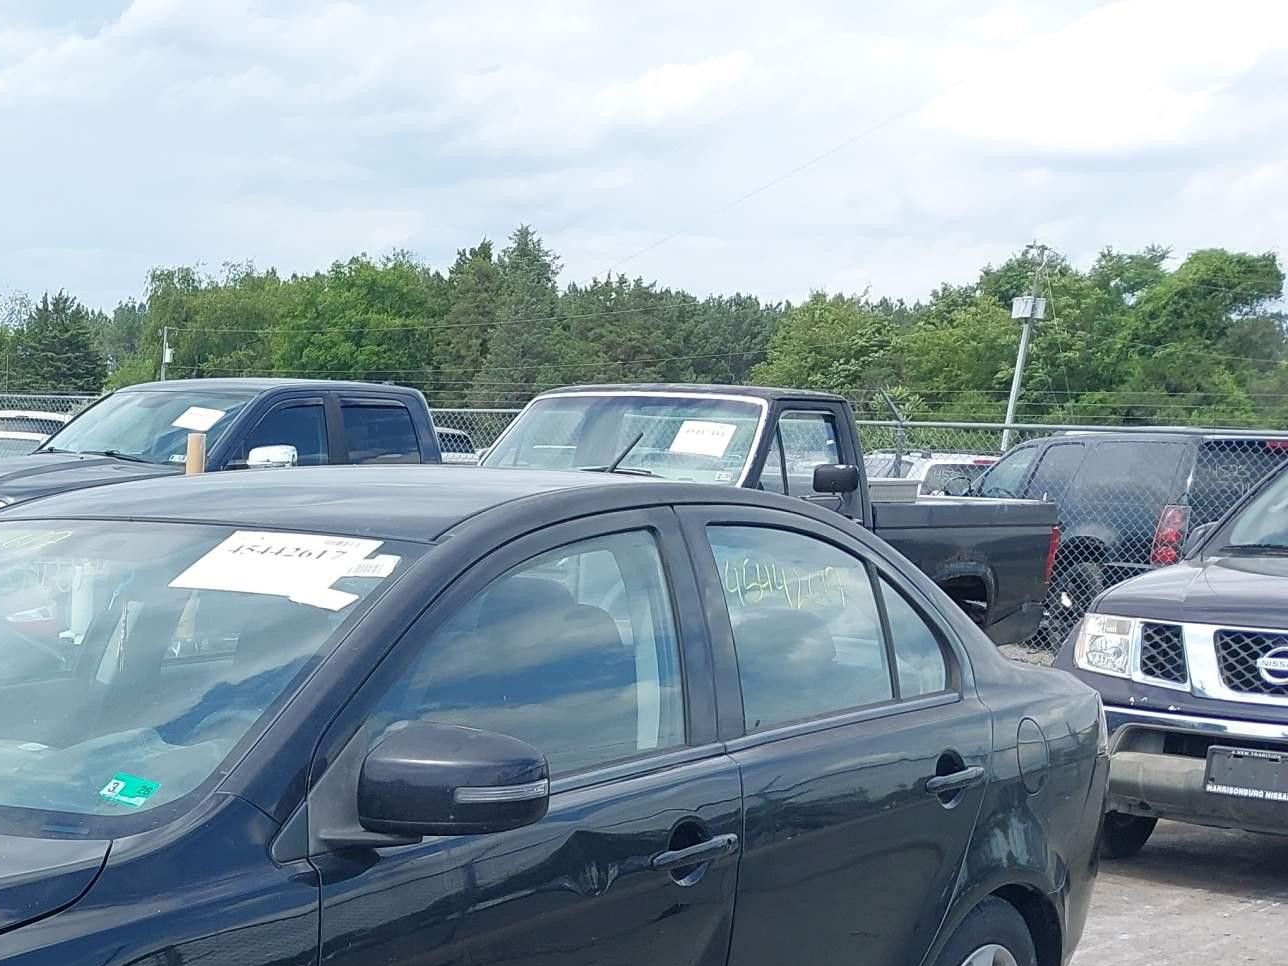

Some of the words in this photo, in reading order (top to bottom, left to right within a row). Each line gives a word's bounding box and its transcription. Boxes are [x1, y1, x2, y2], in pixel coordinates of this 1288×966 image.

[228, 544, 348, 560] 45442617
[1261, 660, 1288, 668] NISS
[108, 782, 119, 792] 3
[1265, 791, 1288, 801] NISSA
